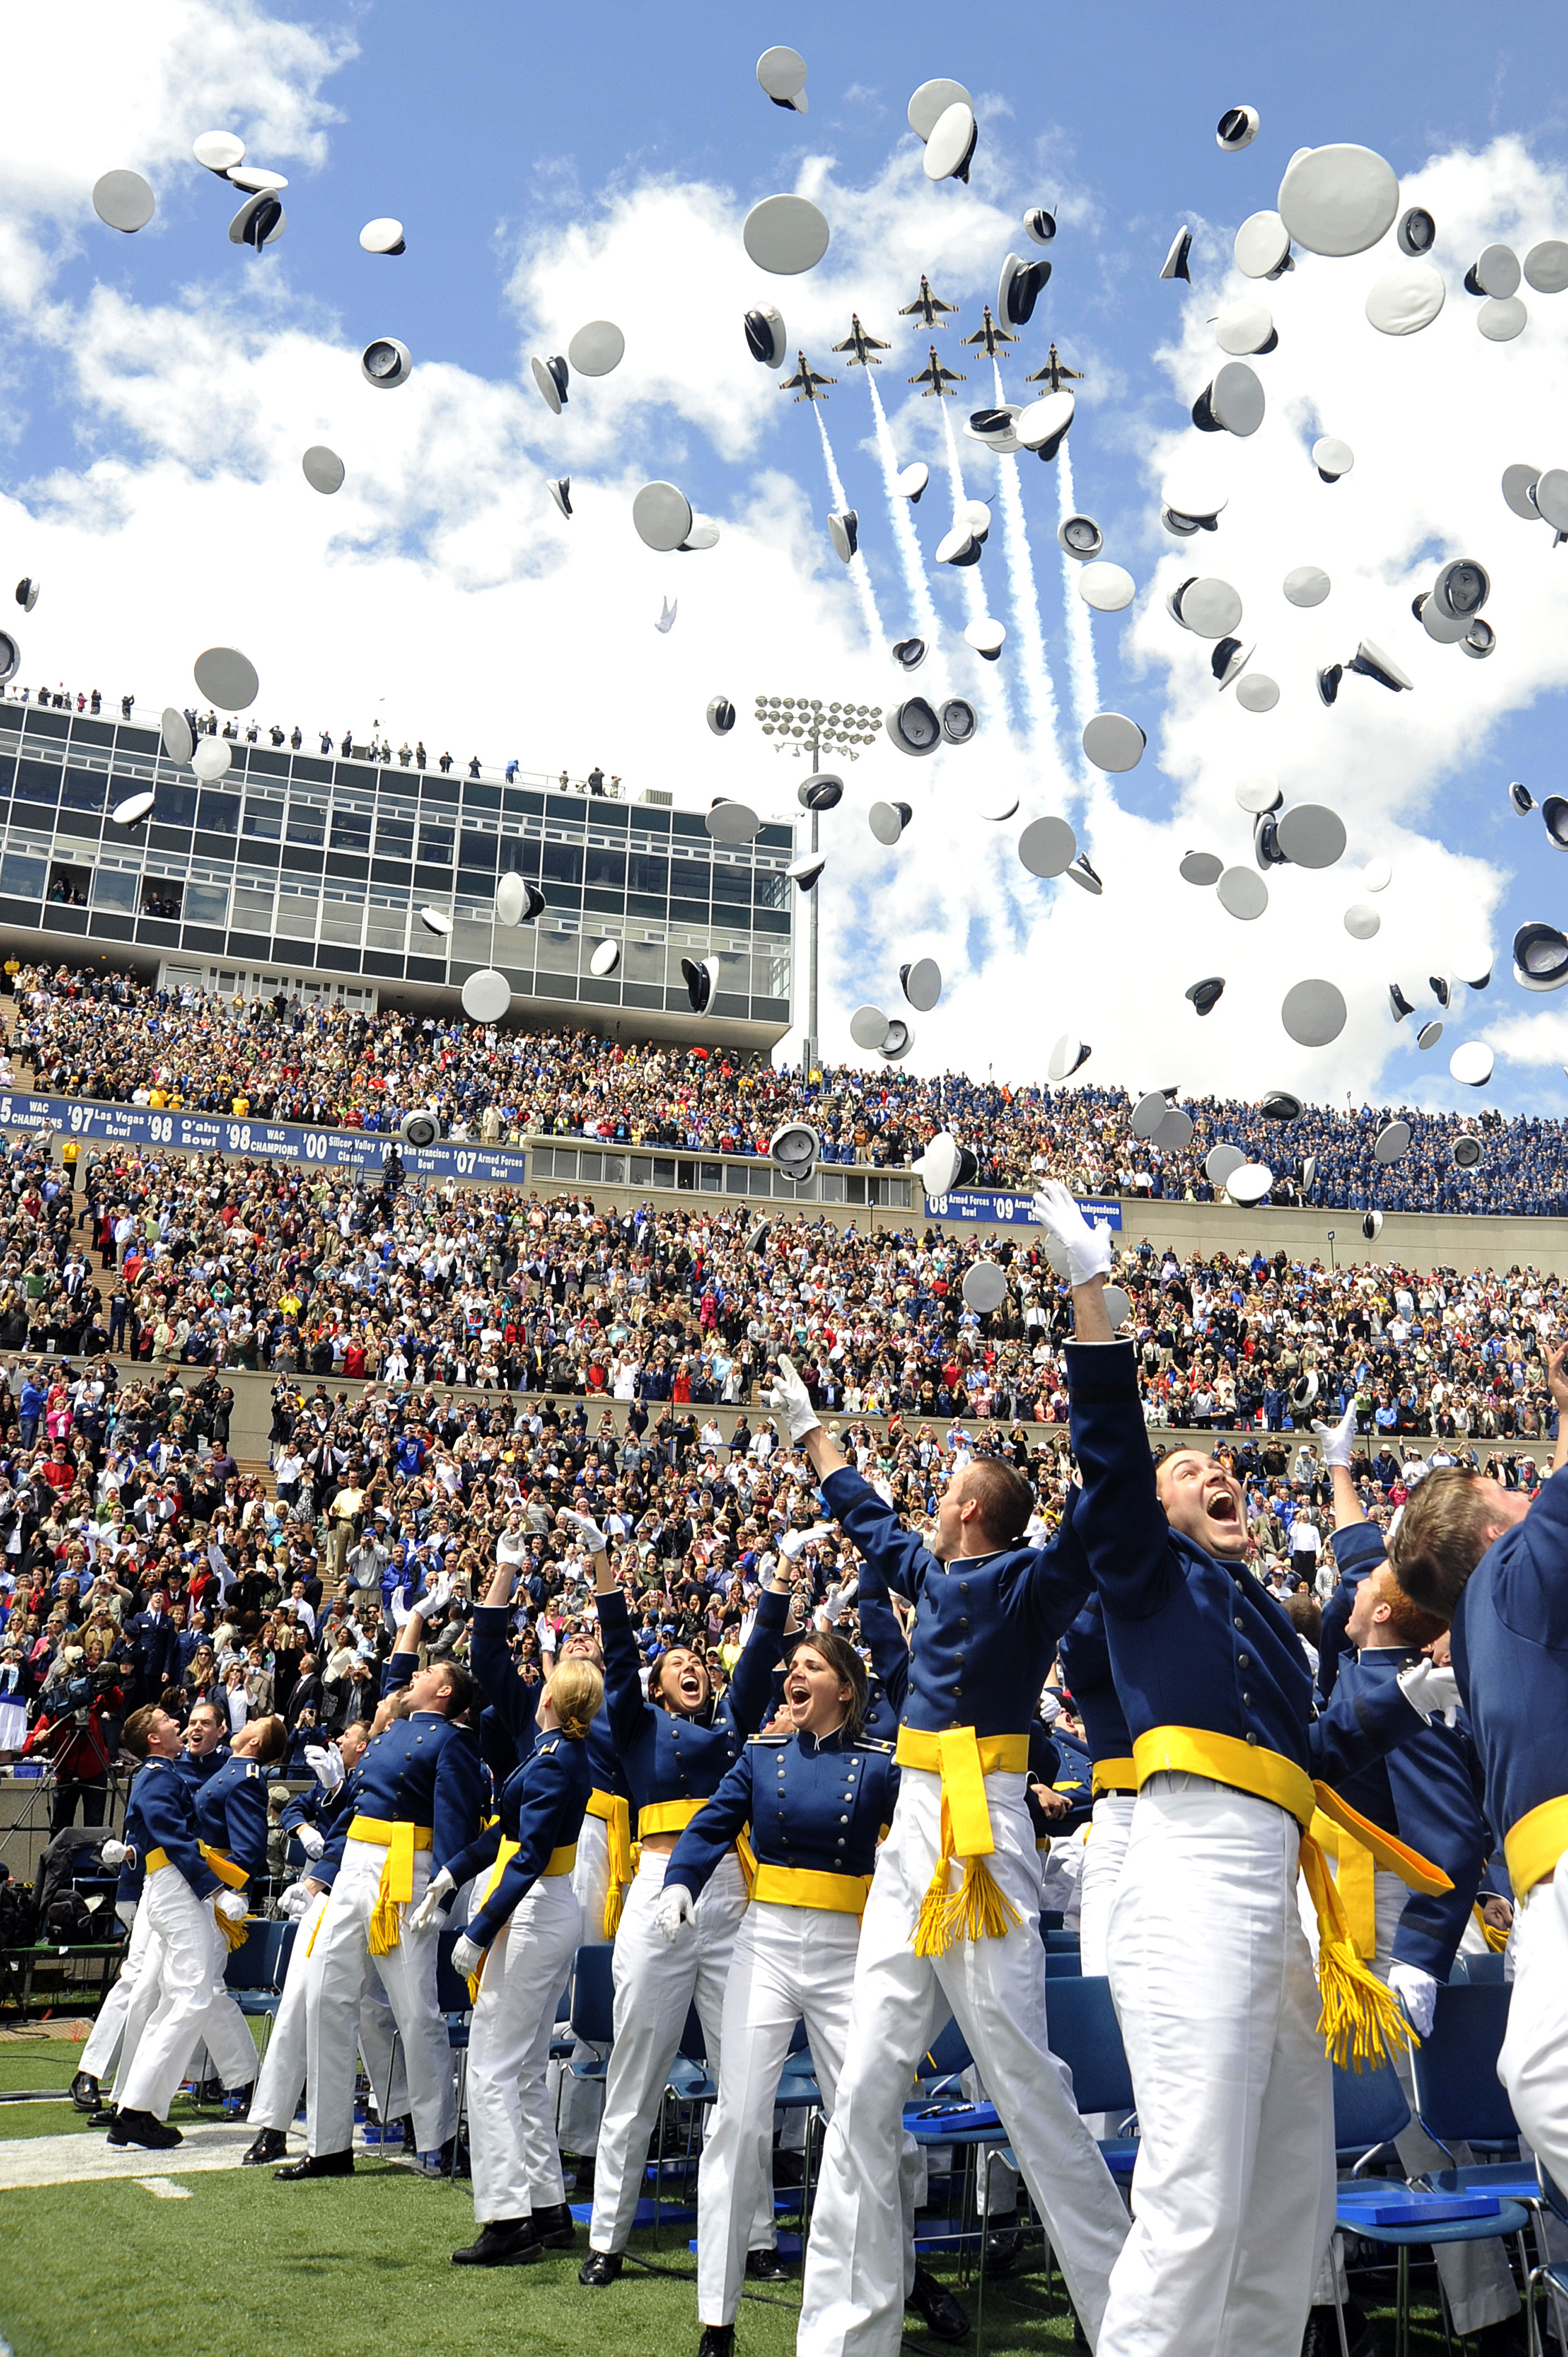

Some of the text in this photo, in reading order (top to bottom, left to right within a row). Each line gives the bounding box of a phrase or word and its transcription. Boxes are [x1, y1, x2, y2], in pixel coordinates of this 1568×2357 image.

[29, 1101, 49, 1113] WAC
[11, 1113, 63, 1129] CHAMPINS
[67, 1105, 94, 1133] '97
[94, 1109, 145, 1125] Las Vegas
[106, 1124, 131, 1137] Bowl
[147, 1115, 173, 1142] '98
[182, 1119, 220, 1134] O'ahu
[182, 1133, 216, 1147] Bowl
[226, 1124, 251, 1150] '98
[267, 1129, 285, 1141] WAC
[250, 1141, 299, 1156] CHAMPIONS
[303, 1133, 327, 1159] '00
[328, 1136, 376, 1153] Silicon Valley
[404, 1145, 450, 1159] San Francisco
[417, 1159, 434, 1170] Bowl
[453, 1150, 477, 1174] '07
[477, 1153, 523, 1167] Armed Forces
[491, 1167, 508, 1178] Bowl
[926, 1194, 948, 1214] '08
[948, 1194, 989, 1206] Armed Forces
[1014, 1199, 1034, 1210] Armed
[962, 1206, 976, 1217] Bowl
[993, 1197, 1014, 1219] '09
[1081, 1203, 1120, 1215] Independence
[1027, 1211, 1040, 1221] Bo
[1094, 1216, 1107, 1224] Bowl
